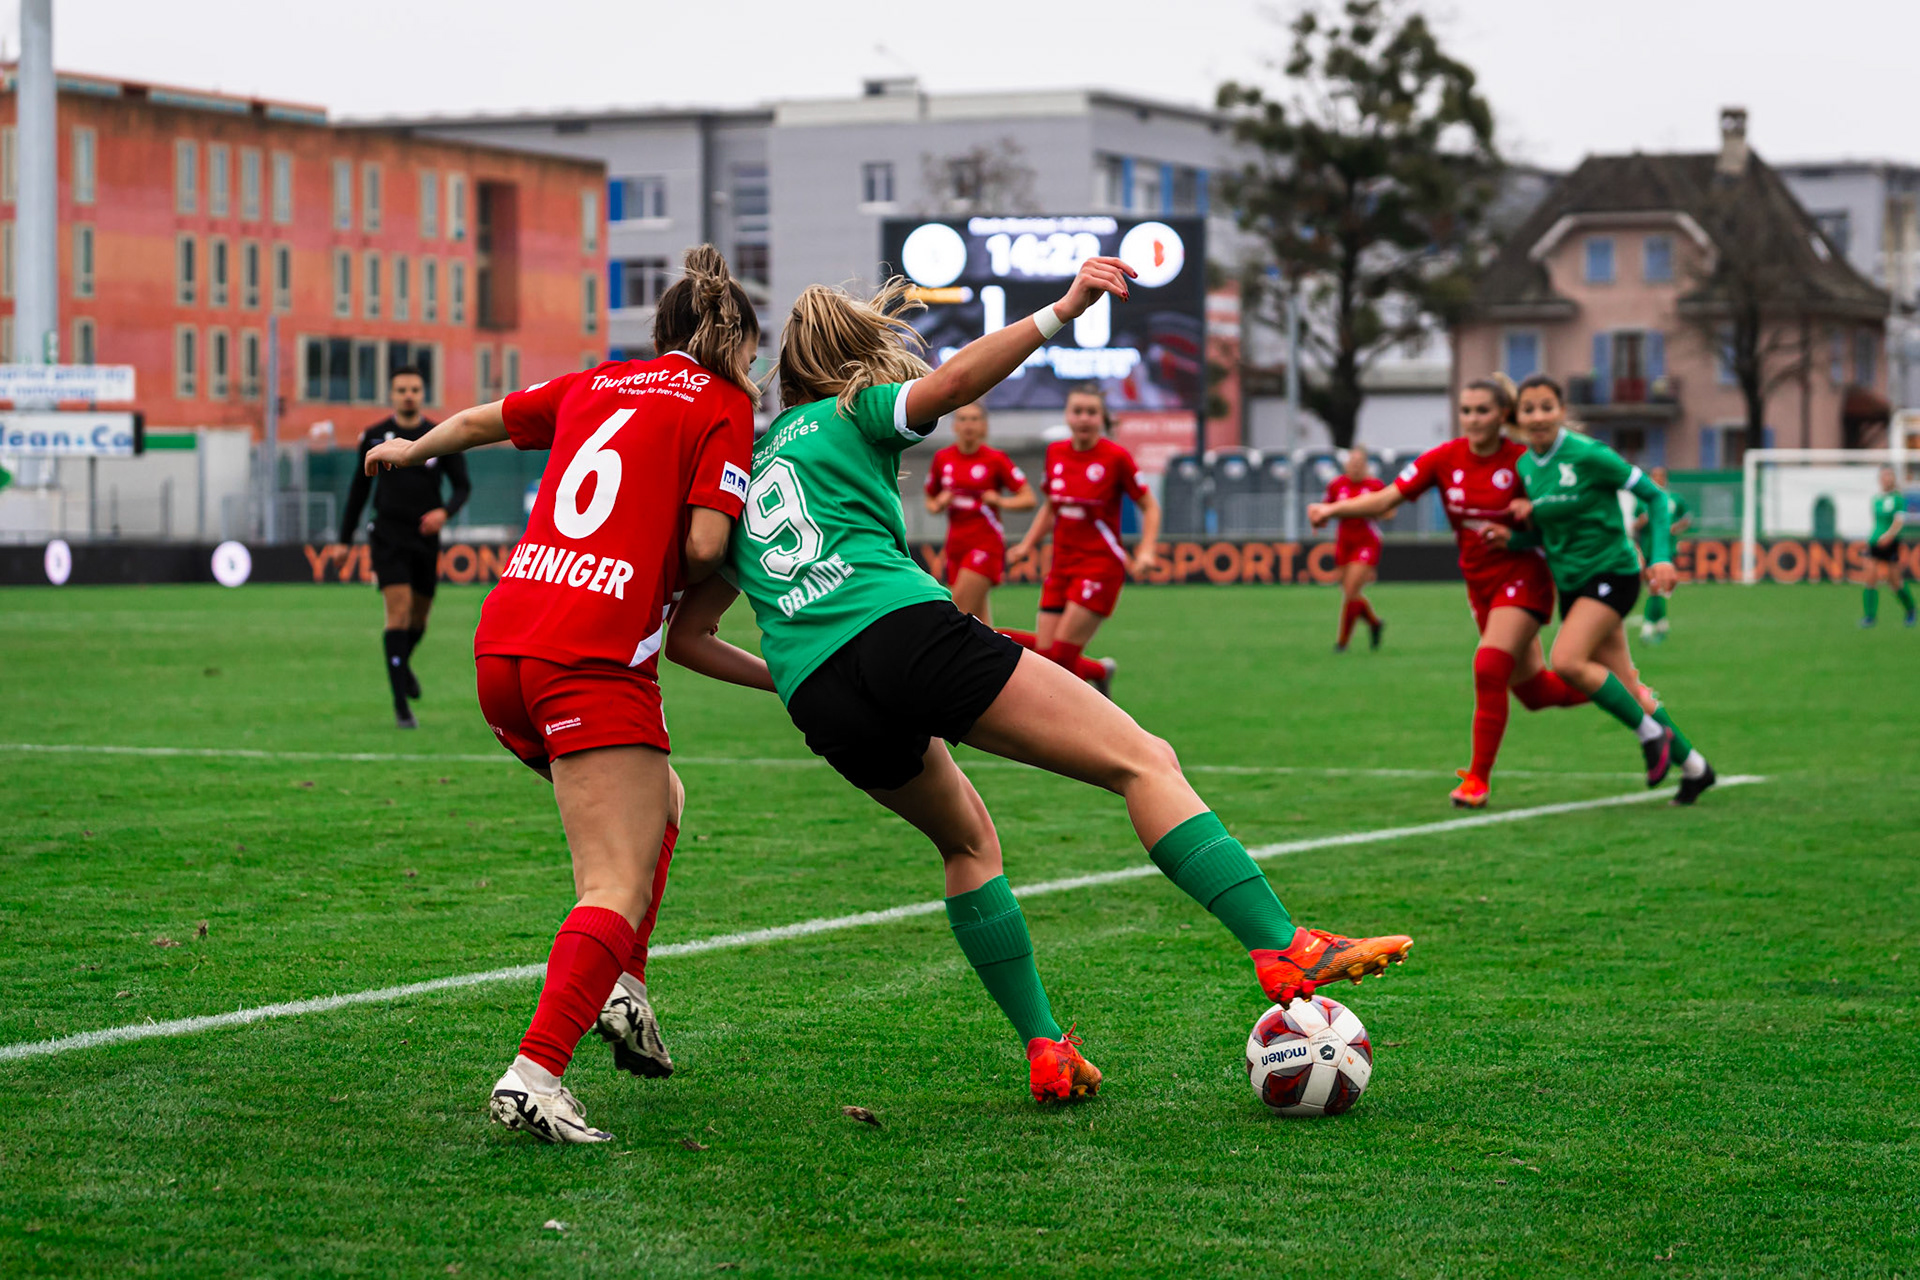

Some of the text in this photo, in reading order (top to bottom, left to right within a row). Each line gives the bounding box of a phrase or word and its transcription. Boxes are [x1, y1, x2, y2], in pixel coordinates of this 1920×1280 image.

[670, 369, 711, 386] AG
[673, 390, 695, 403] Anlass
[682, 383, 703, 392] 1990
[752, 420, 819, 470] opulaires
[553, 408, 638, 539] 6
[742, 456, 824, 582] 9
[502, 542, 634, 600] HEINIGER
[777, 552, 855, 618] GRANDE
[1261, 1046, 1307, 1066] molten
